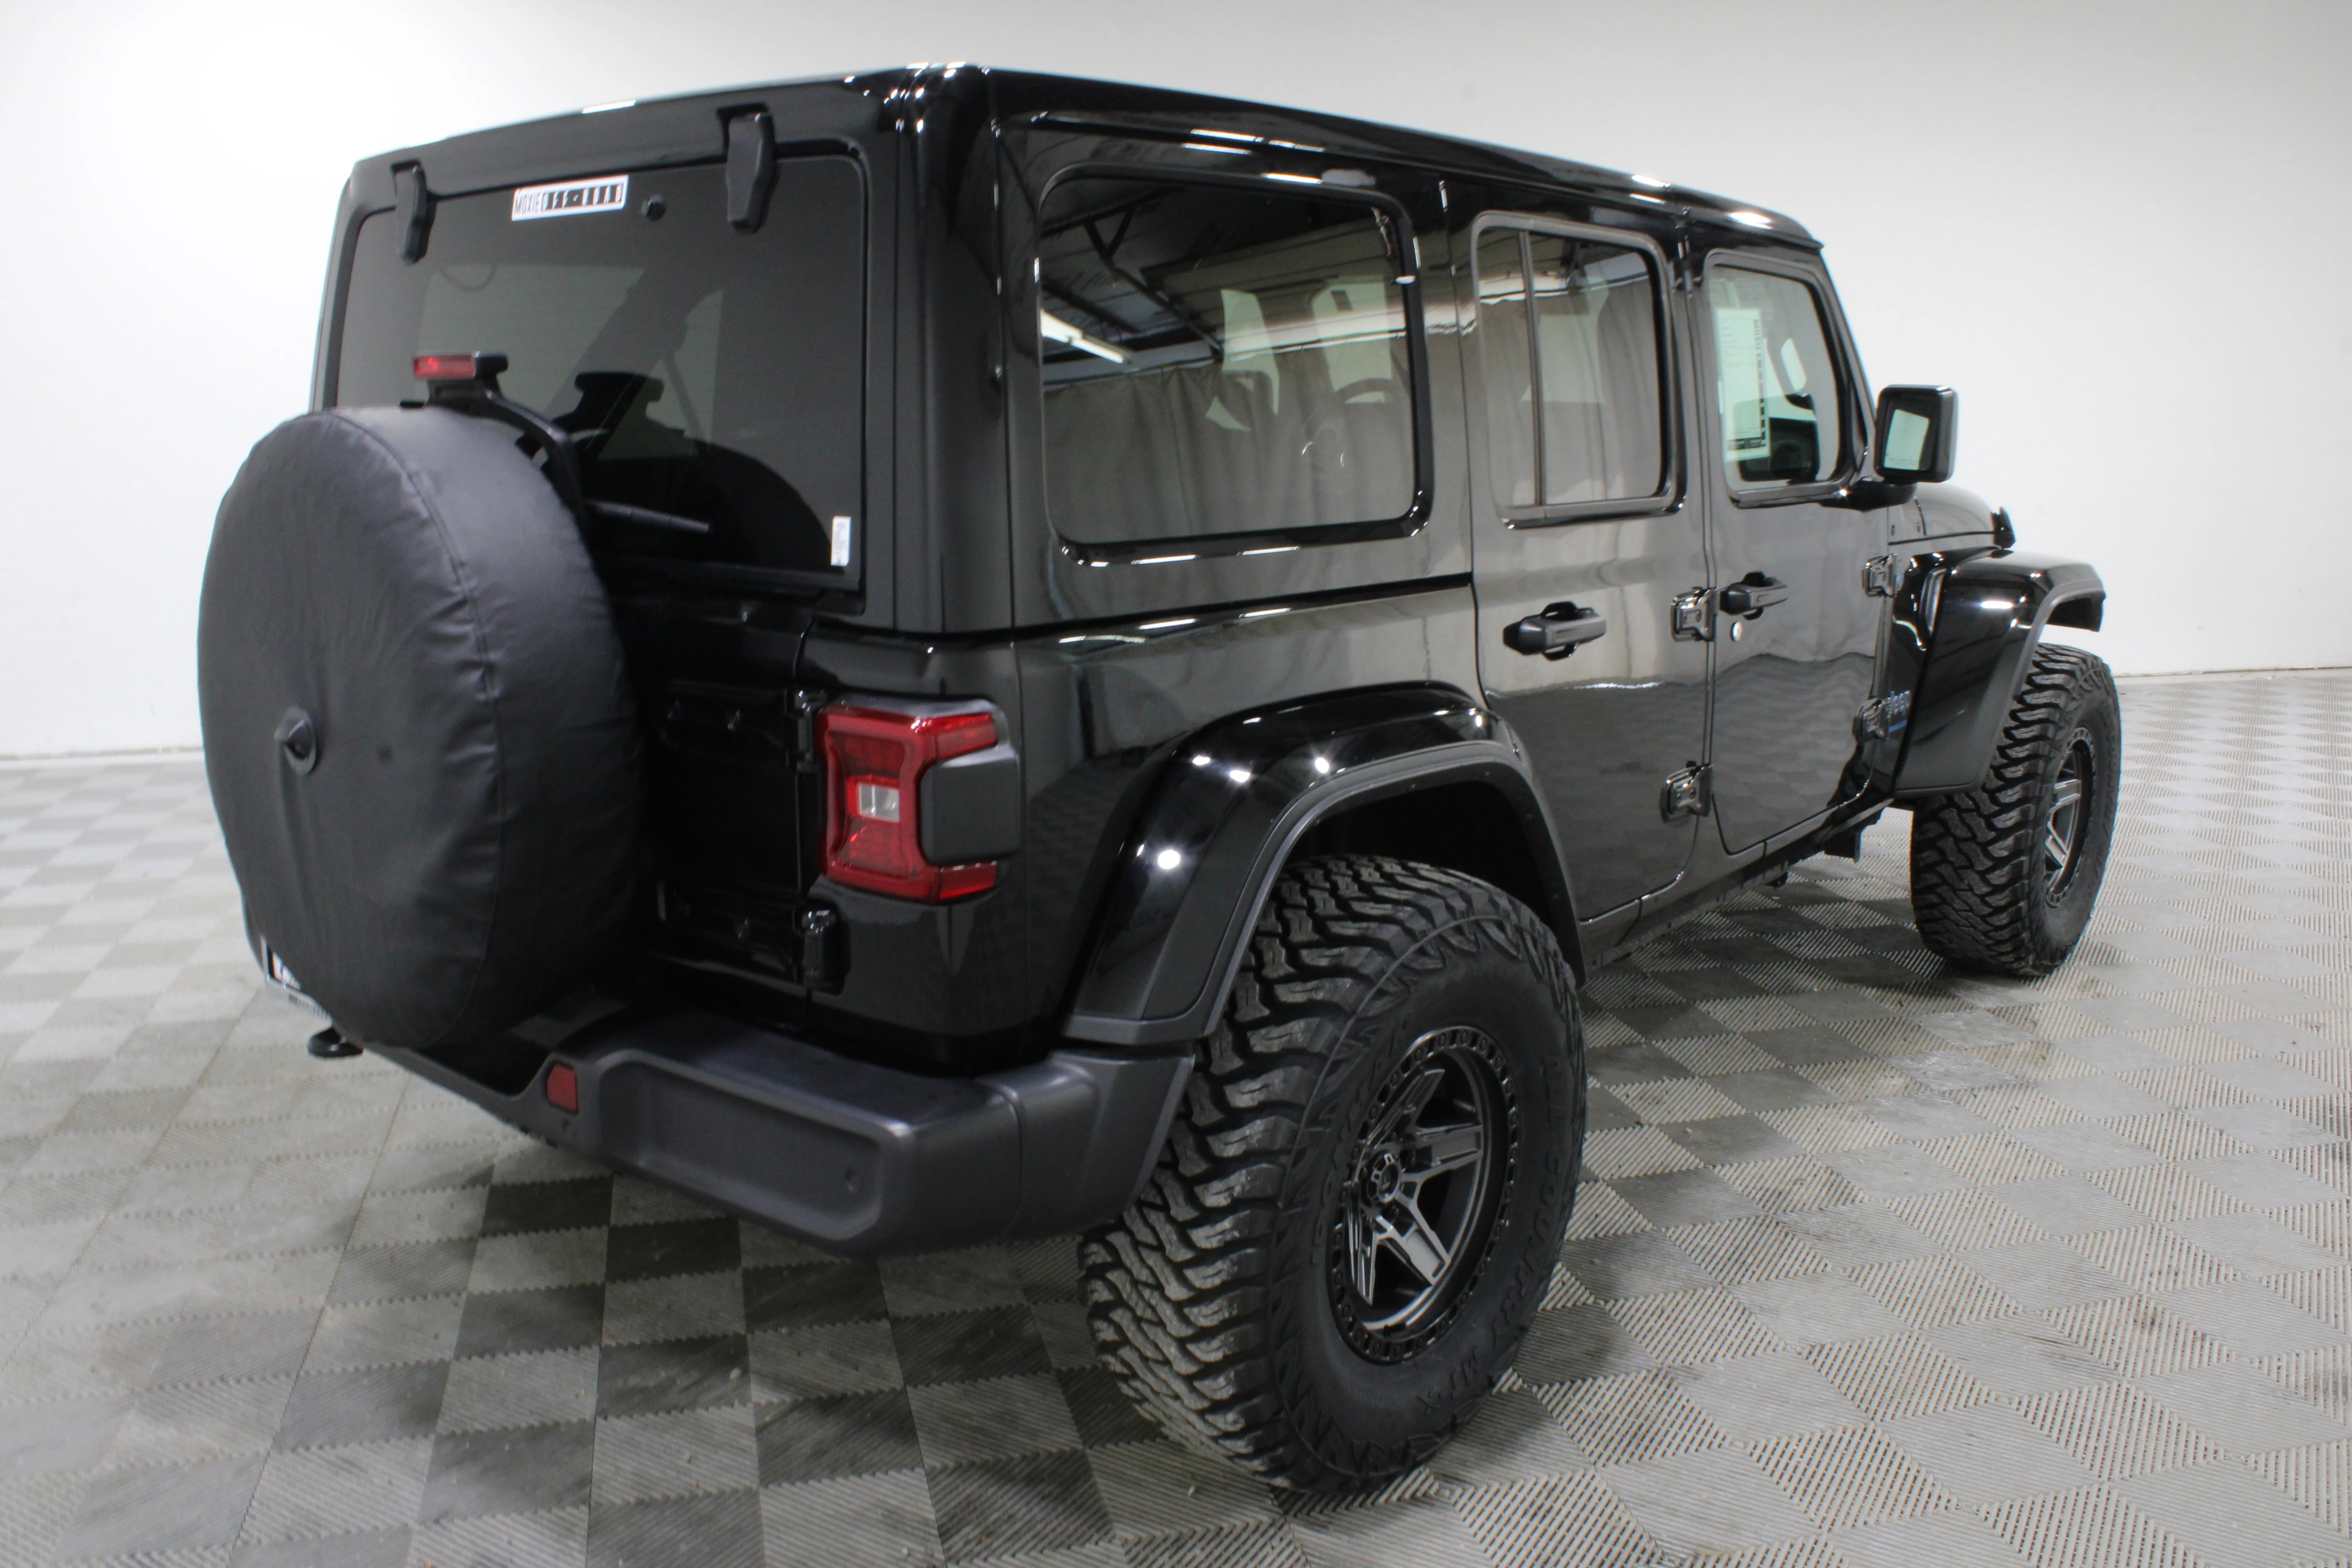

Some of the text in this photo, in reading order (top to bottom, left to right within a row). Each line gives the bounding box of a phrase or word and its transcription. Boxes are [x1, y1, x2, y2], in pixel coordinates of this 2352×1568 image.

[514, 184, 621, 216] MOXIE OFF-ROAD
[1490, 1146, 1563, 1352] COUNTRY
